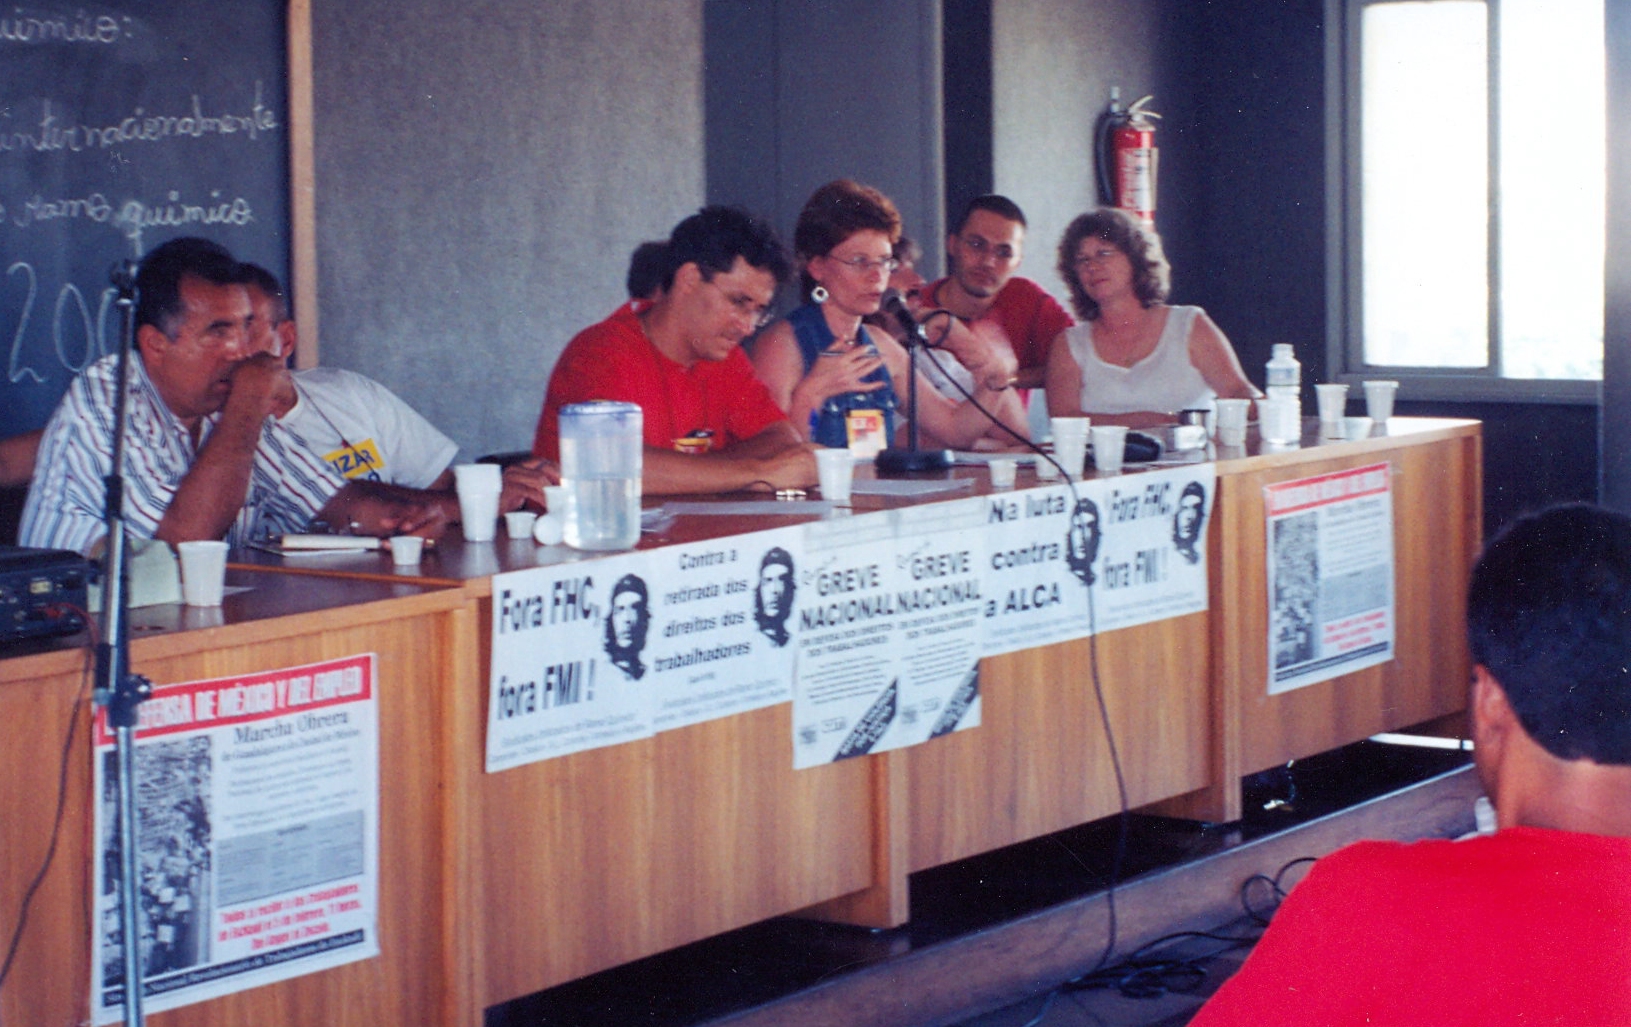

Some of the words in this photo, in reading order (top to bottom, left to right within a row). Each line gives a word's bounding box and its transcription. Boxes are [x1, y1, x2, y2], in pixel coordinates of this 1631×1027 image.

[331, 447, 376, 476] IZAR
[988, 499, 1018, 524] Na
[1026, 494, 1066, 519] luta
[679, 551, 726, 571] Contra
[911, 550, 971, 581] GREVE
[991, 541, 1060, 570] contra
[662, 580, 721, 606] retirada
[724, 578, 749, 596] dos
[817, 564, 880, 597] GREVE
[897, 579, 982, 613] NACIONAL
[501, 589, 543, 634] Fora
[550, 576, 601, 628] FHC,
[799, 592, 895, 632] NACIONAL
[1004, 582, 1062, 614] ALCA
[662, 613, 718, 638] direitos
[721, 609, 747, 628] dos
[654, 640, 752, 673] trabalhadores
[136, 692, 193, 731] EFENSA
[195, 690, 217, 721] DE
[218, 682, 275, 718] MÉXICO
[276, 679, 287, 708] Y
[498, 676, 536, 720] fora
[542, 660, 582, 710] FMI
[234, 717, 293, 745] Marcha
[296, 710, 350, 735] Obrera
